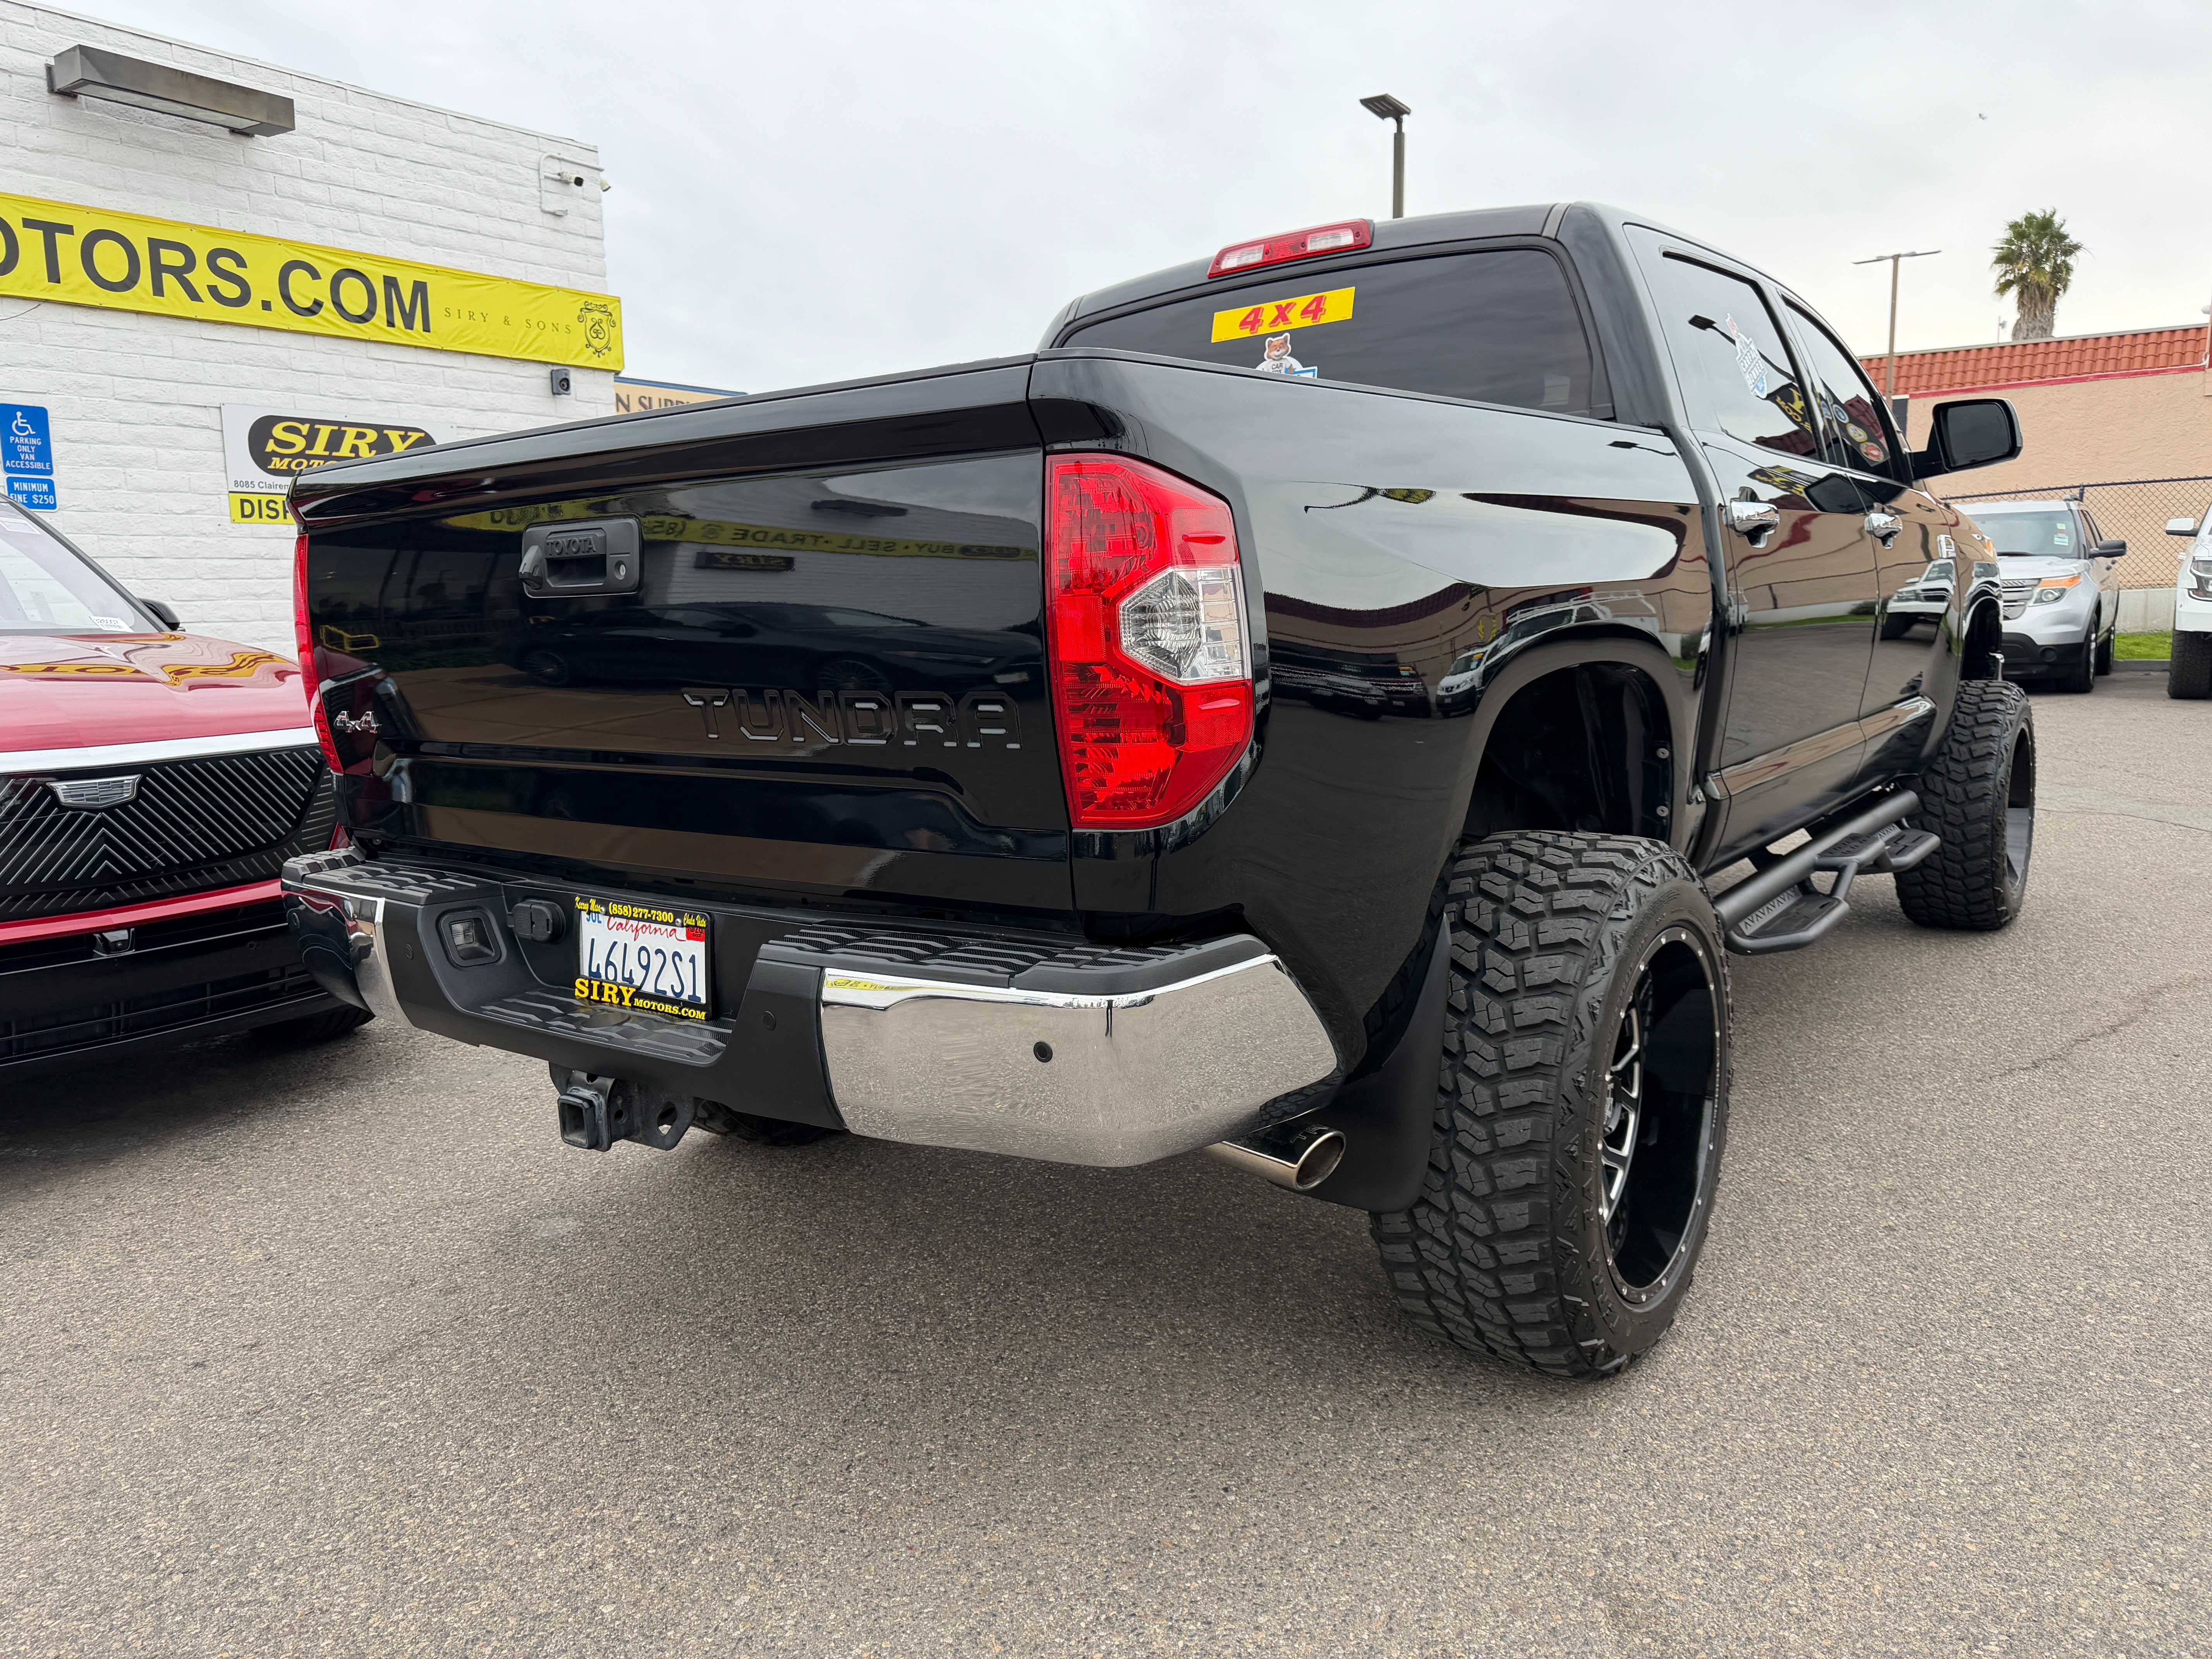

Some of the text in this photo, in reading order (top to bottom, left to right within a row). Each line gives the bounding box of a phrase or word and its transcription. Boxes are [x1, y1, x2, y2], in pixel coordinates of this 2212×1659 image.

[444, 307, 572, 334] SIRY & SONS
[10, 436, 41, 445] PARKING
[265, 421, 425, 458] SIRY
[6, 460, 51, 470] ACCESSIBLE
[13, 482, 48, 492] MINIMUM
[234, 480, 255, 488] 8085
[32, 495, 54, 505] $250
[546, 536, 597, 556] TOYOTA
[681, 687, 1022, 749] TUNDRA
[609, 902, 632, 917] (858)
[633, 906, 673, 924] 277-7300
[586, 912, 602, 924] JUL
[607, 916, 686, 942] California
[588, 938, 702, 1003] 46492S1
[575, 978, 707, 1020] SIRY MOTORS.COM
